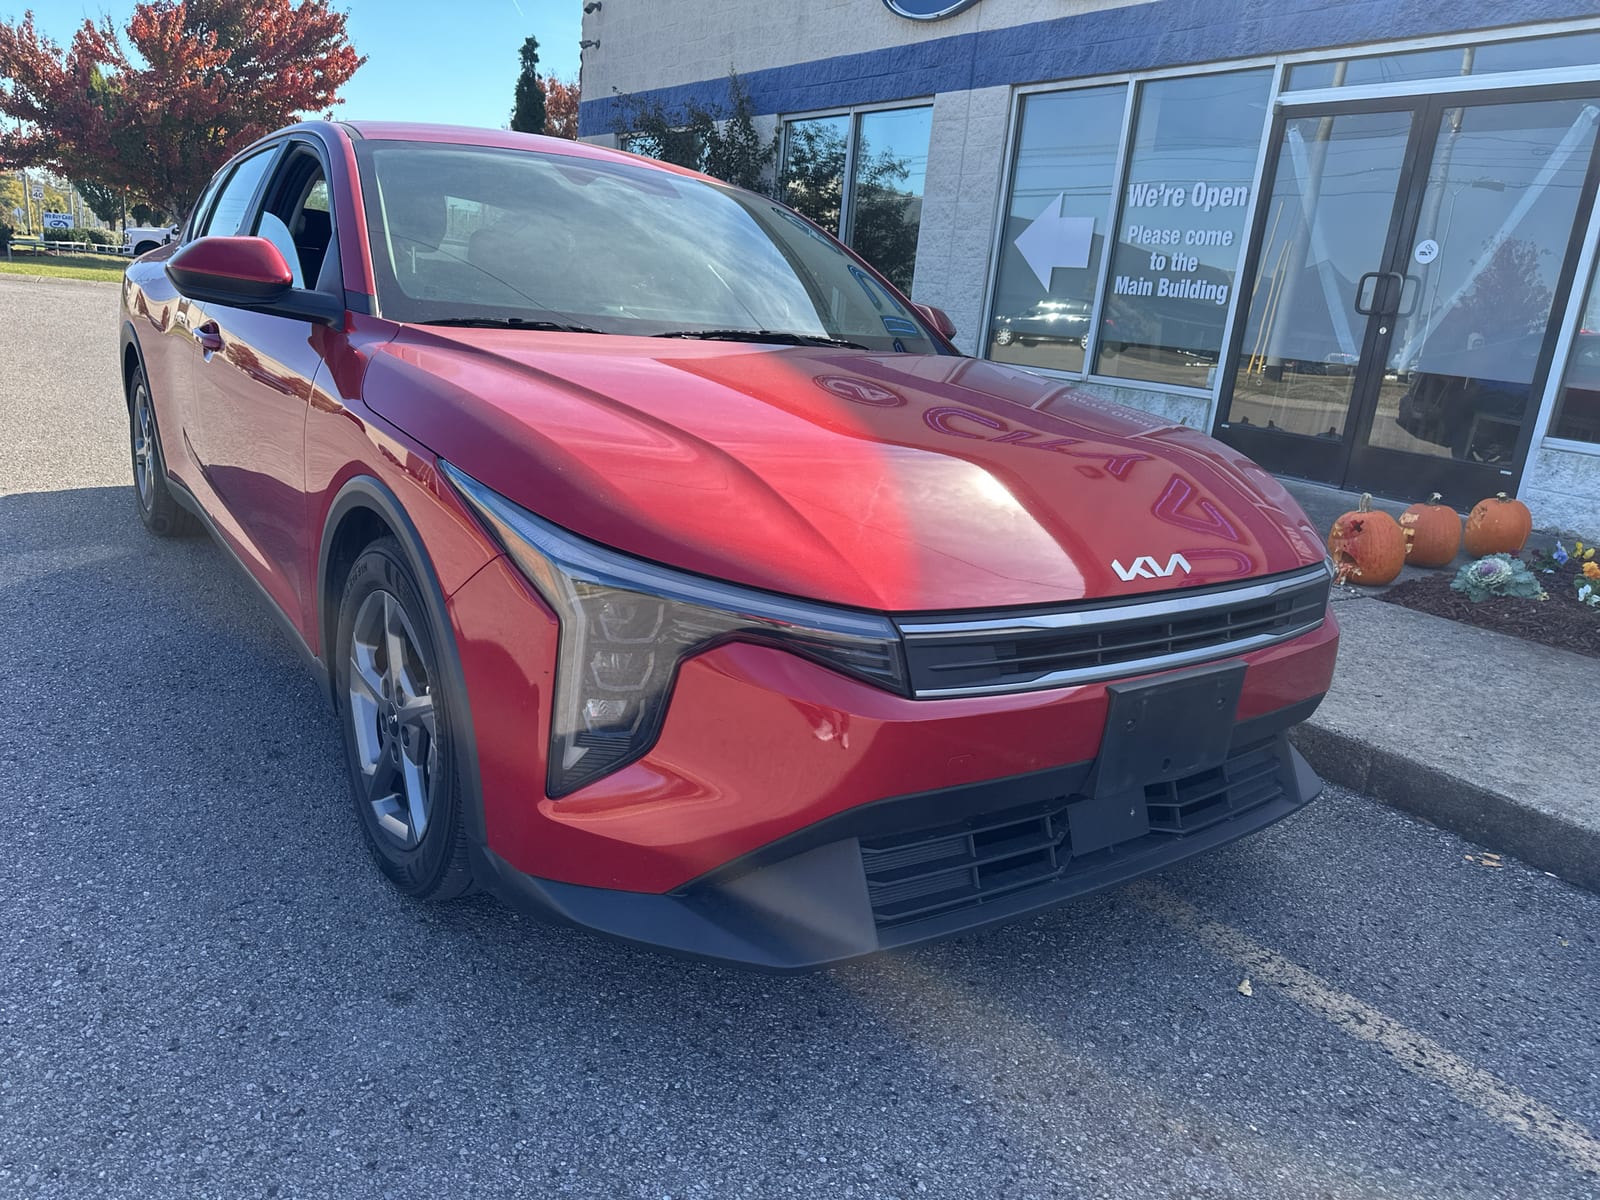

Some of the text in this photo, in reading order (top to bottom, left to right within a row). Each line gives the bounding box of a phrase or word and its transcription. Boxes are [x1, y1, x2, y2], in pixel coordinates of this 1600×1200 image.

[1128, 181, 1248, 212] We're Open
[1127, 225, 1233, 247] Please come
[1150, 252, 1199, 272] to the
[1114, 275, 1229, 305] Main Building
[1111, 553, 1192, 582] KIA
